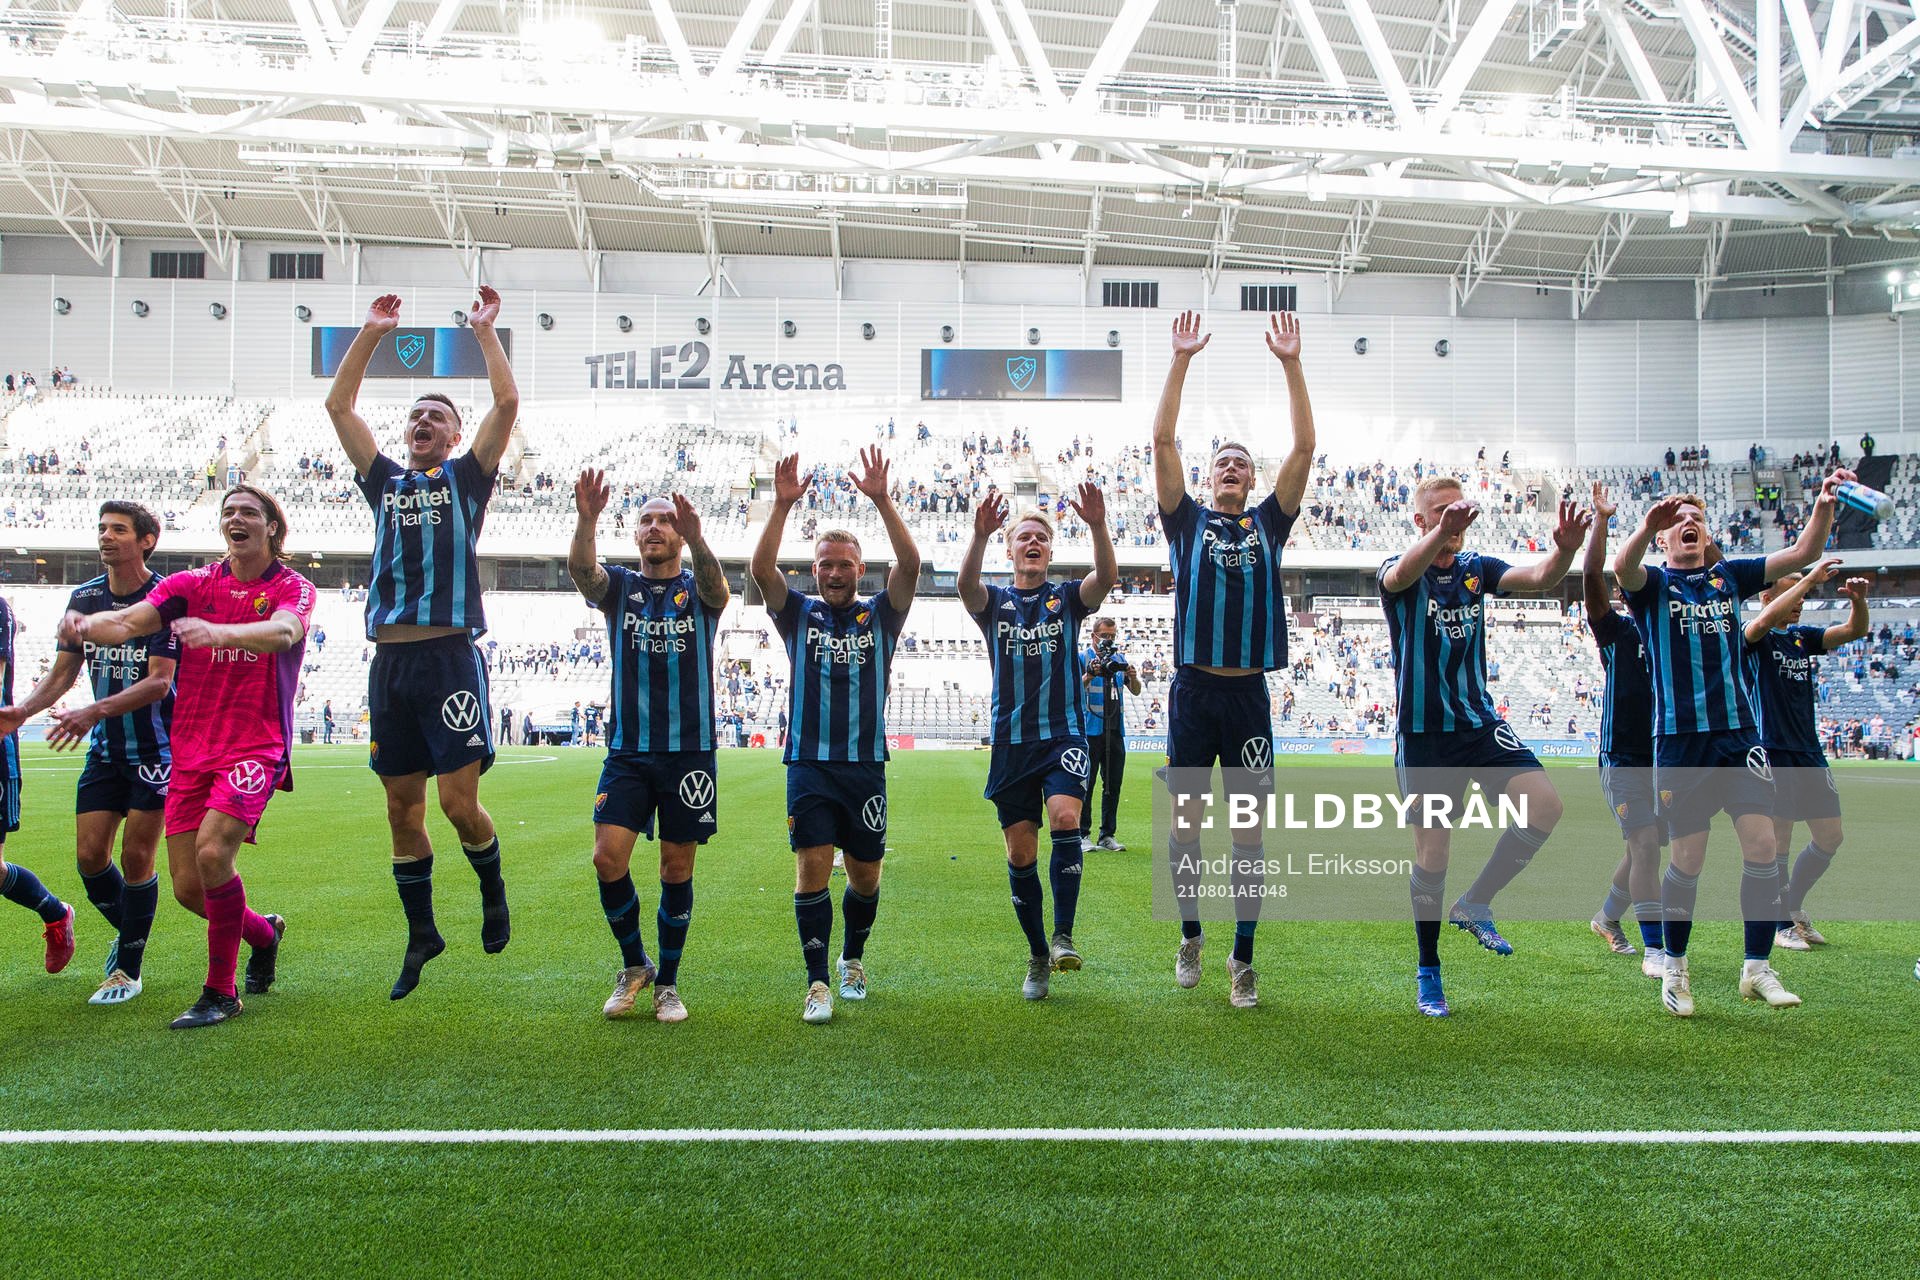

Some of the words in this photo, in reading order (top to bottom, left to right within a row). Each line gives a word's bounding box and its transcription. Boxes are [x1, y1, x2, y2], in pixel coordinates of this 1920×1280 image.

[584, 341, 711, 390] TELE2
[720, 354, 847, 390] Arena
[383, 486, 452, 513] Poritet
[1427, 598, 1480, 622] Piorite
[1668, 597, 1734, 618] Prioritet
[623, 612, 696, 635] Prioritet
[997, 619, 1064, 640] Prioritet
[1680, 617, 1731, 636] Finans
[631, 632, 687, 653] Finans
[806, 627, 875, 651] Prioritet
[1005, 639, 1058, 656] Finans
[83, 641, 147, 661] Prioritet
[814, 645, 866, 665] Finans
[89, 660, 140, 680] Finans
[1280, 741, 1315, 752] Vepor
[1541, 744, 1583, 755] Skyltar
